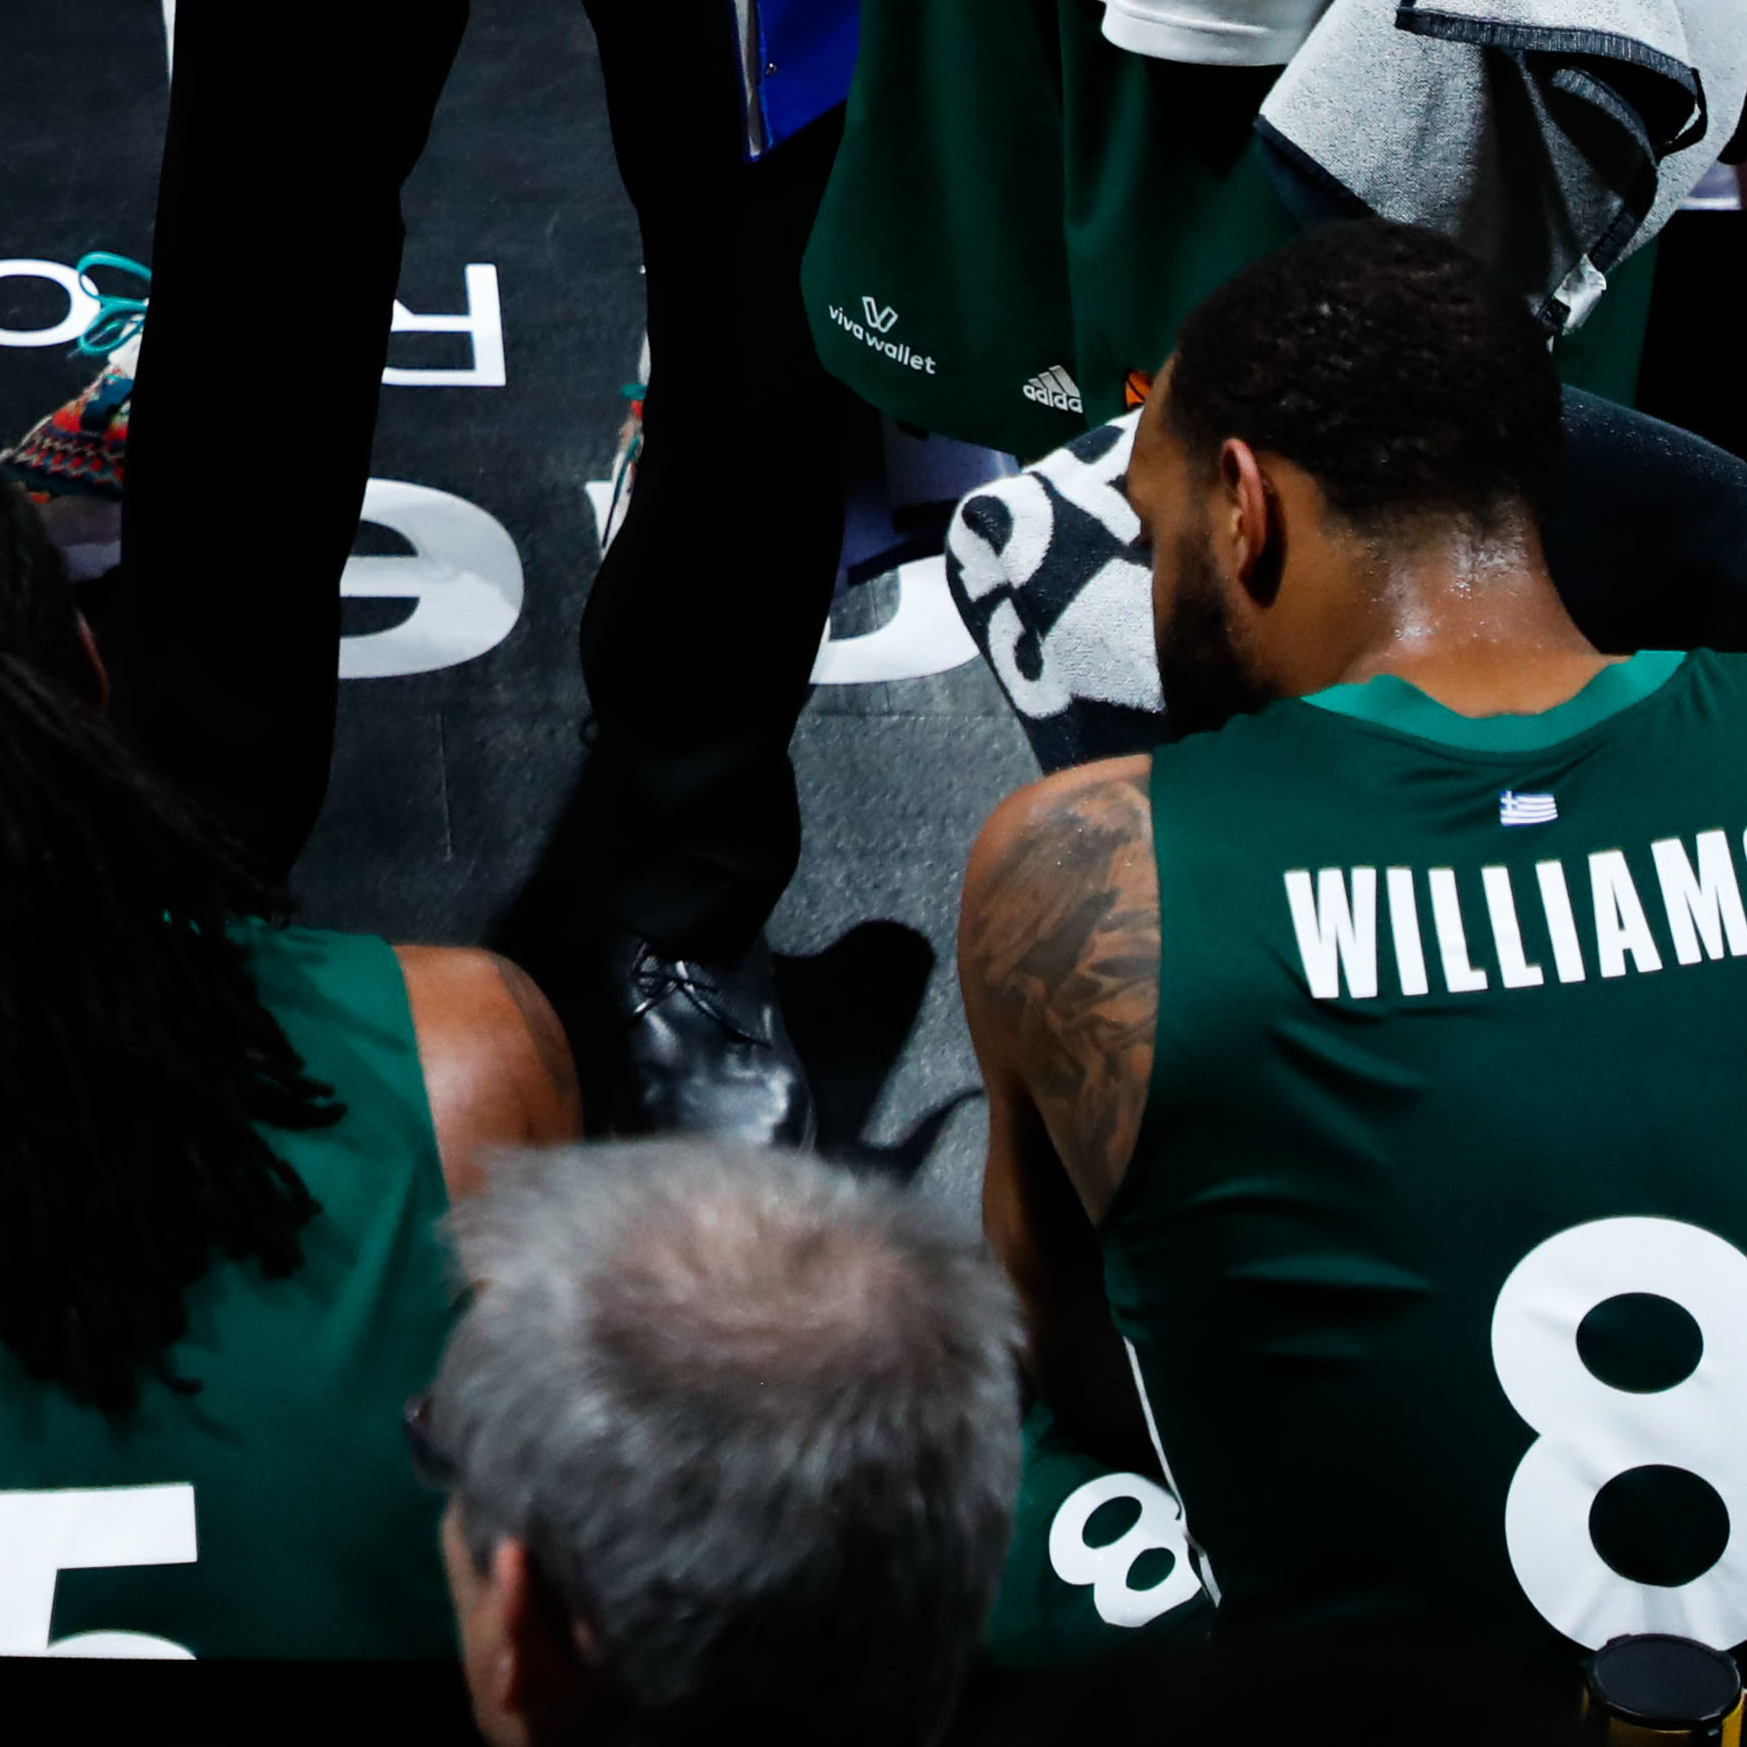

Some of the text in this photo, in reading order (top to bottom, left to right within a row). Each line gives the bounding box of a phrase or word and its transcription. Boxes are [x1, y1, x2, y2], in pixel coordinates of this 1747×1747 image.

[1022, 383, 1084, 413] adida
[1284, 825, 1747, 1000] WILLIAM
[1491, 1215, 1747, 1652] 8
[1049, 1472, 1202, 1629] 8
